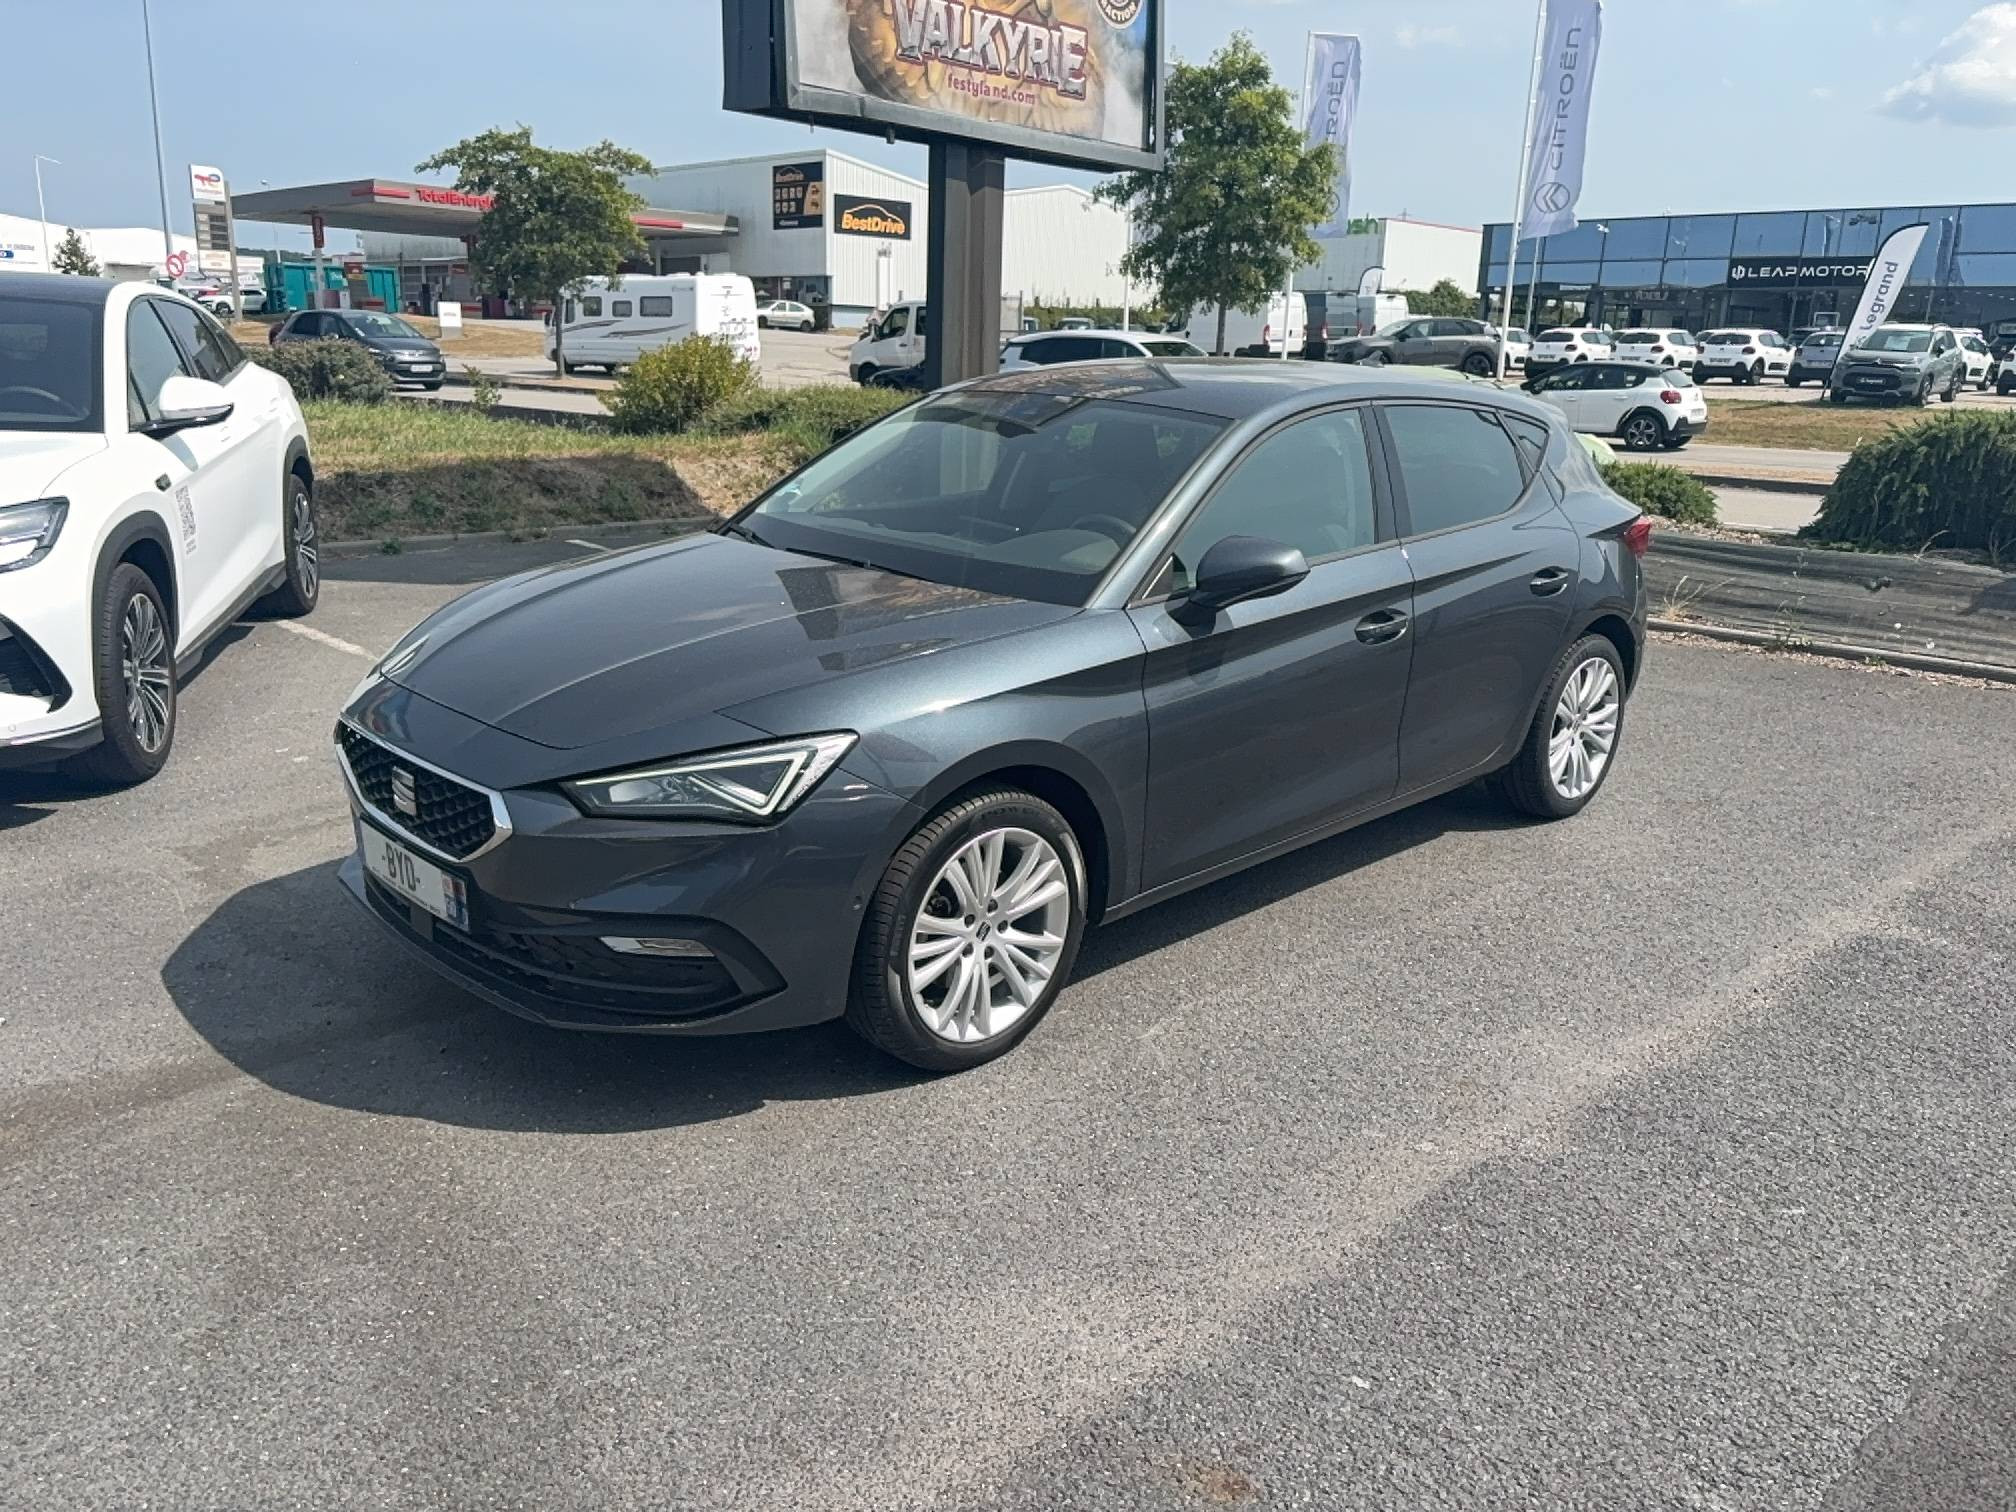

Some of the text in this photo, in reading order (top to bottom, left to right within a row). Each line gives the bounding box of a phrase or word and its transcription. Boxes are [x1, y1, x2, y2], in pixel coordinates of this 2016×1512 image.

[894, 0, 1087, 98] VALKYRIE
[946, 73, 1036, 105] festyland.com
[416, 187, 492, 210] TotalEnerg
[841, 212, 906, 235] BestDrive
